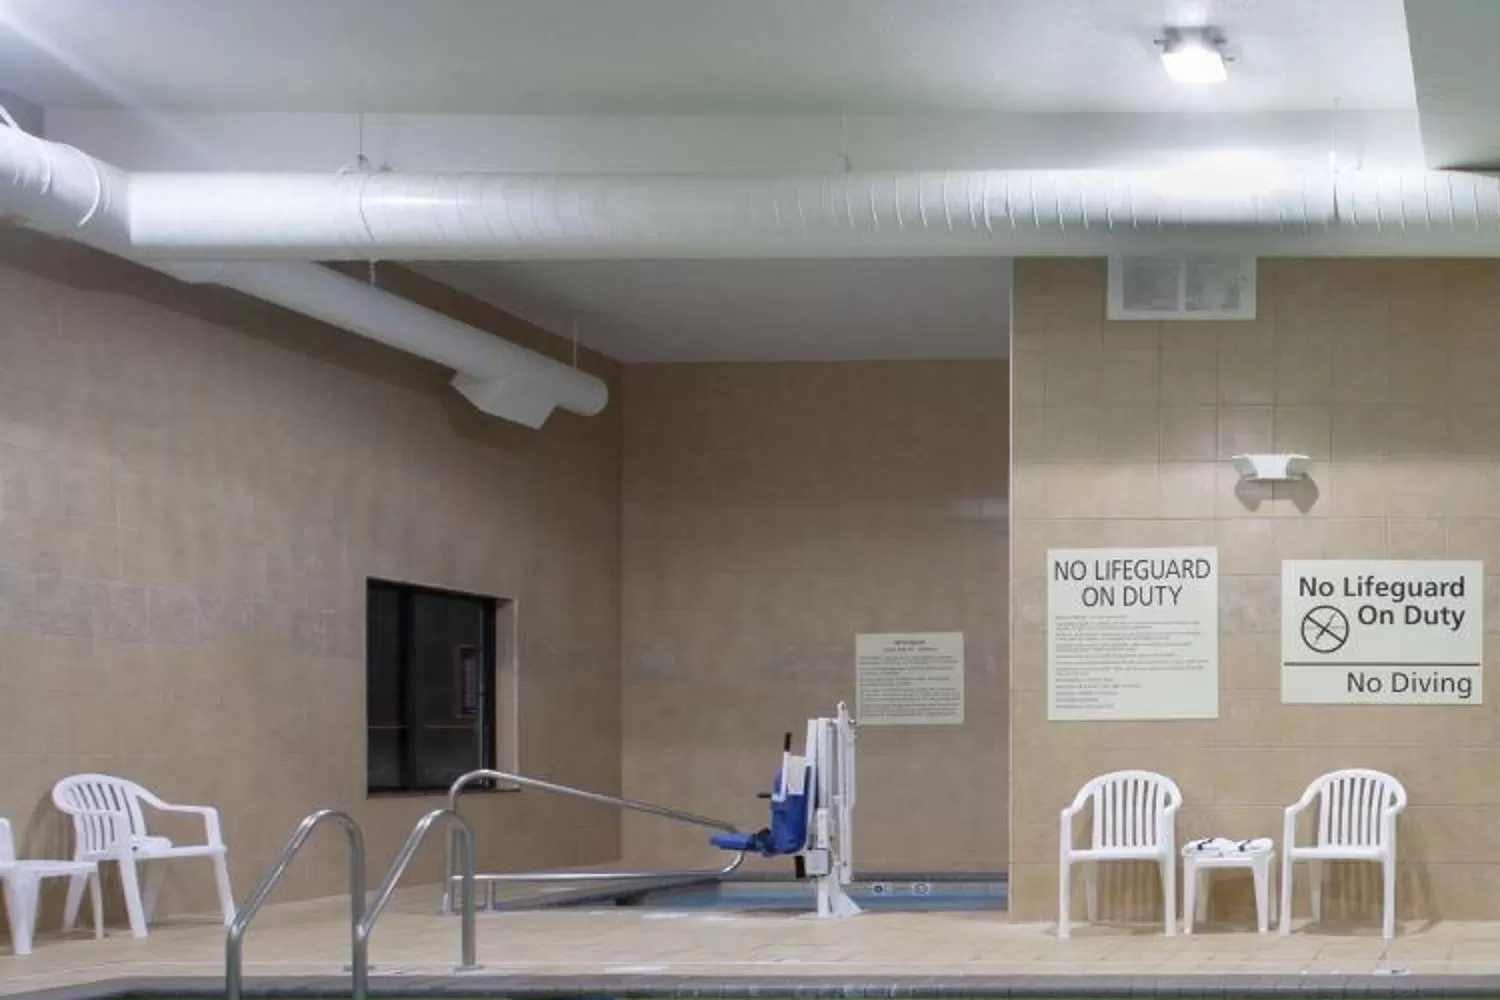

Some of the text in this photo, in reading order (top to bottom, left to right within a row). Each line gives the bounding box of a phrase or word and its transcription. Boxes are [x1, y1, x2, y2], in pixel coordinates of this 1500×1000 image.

[1054, 558, 1211, 581] NO LIFEGUARD
[1081, 584, 1183, 608] ON DUTY
[1299, 575, 1466, 603] No Lifeguard
[1357, 604, 1466, 631] On Duty
[1347, 671, 1473, 699] No Diving
